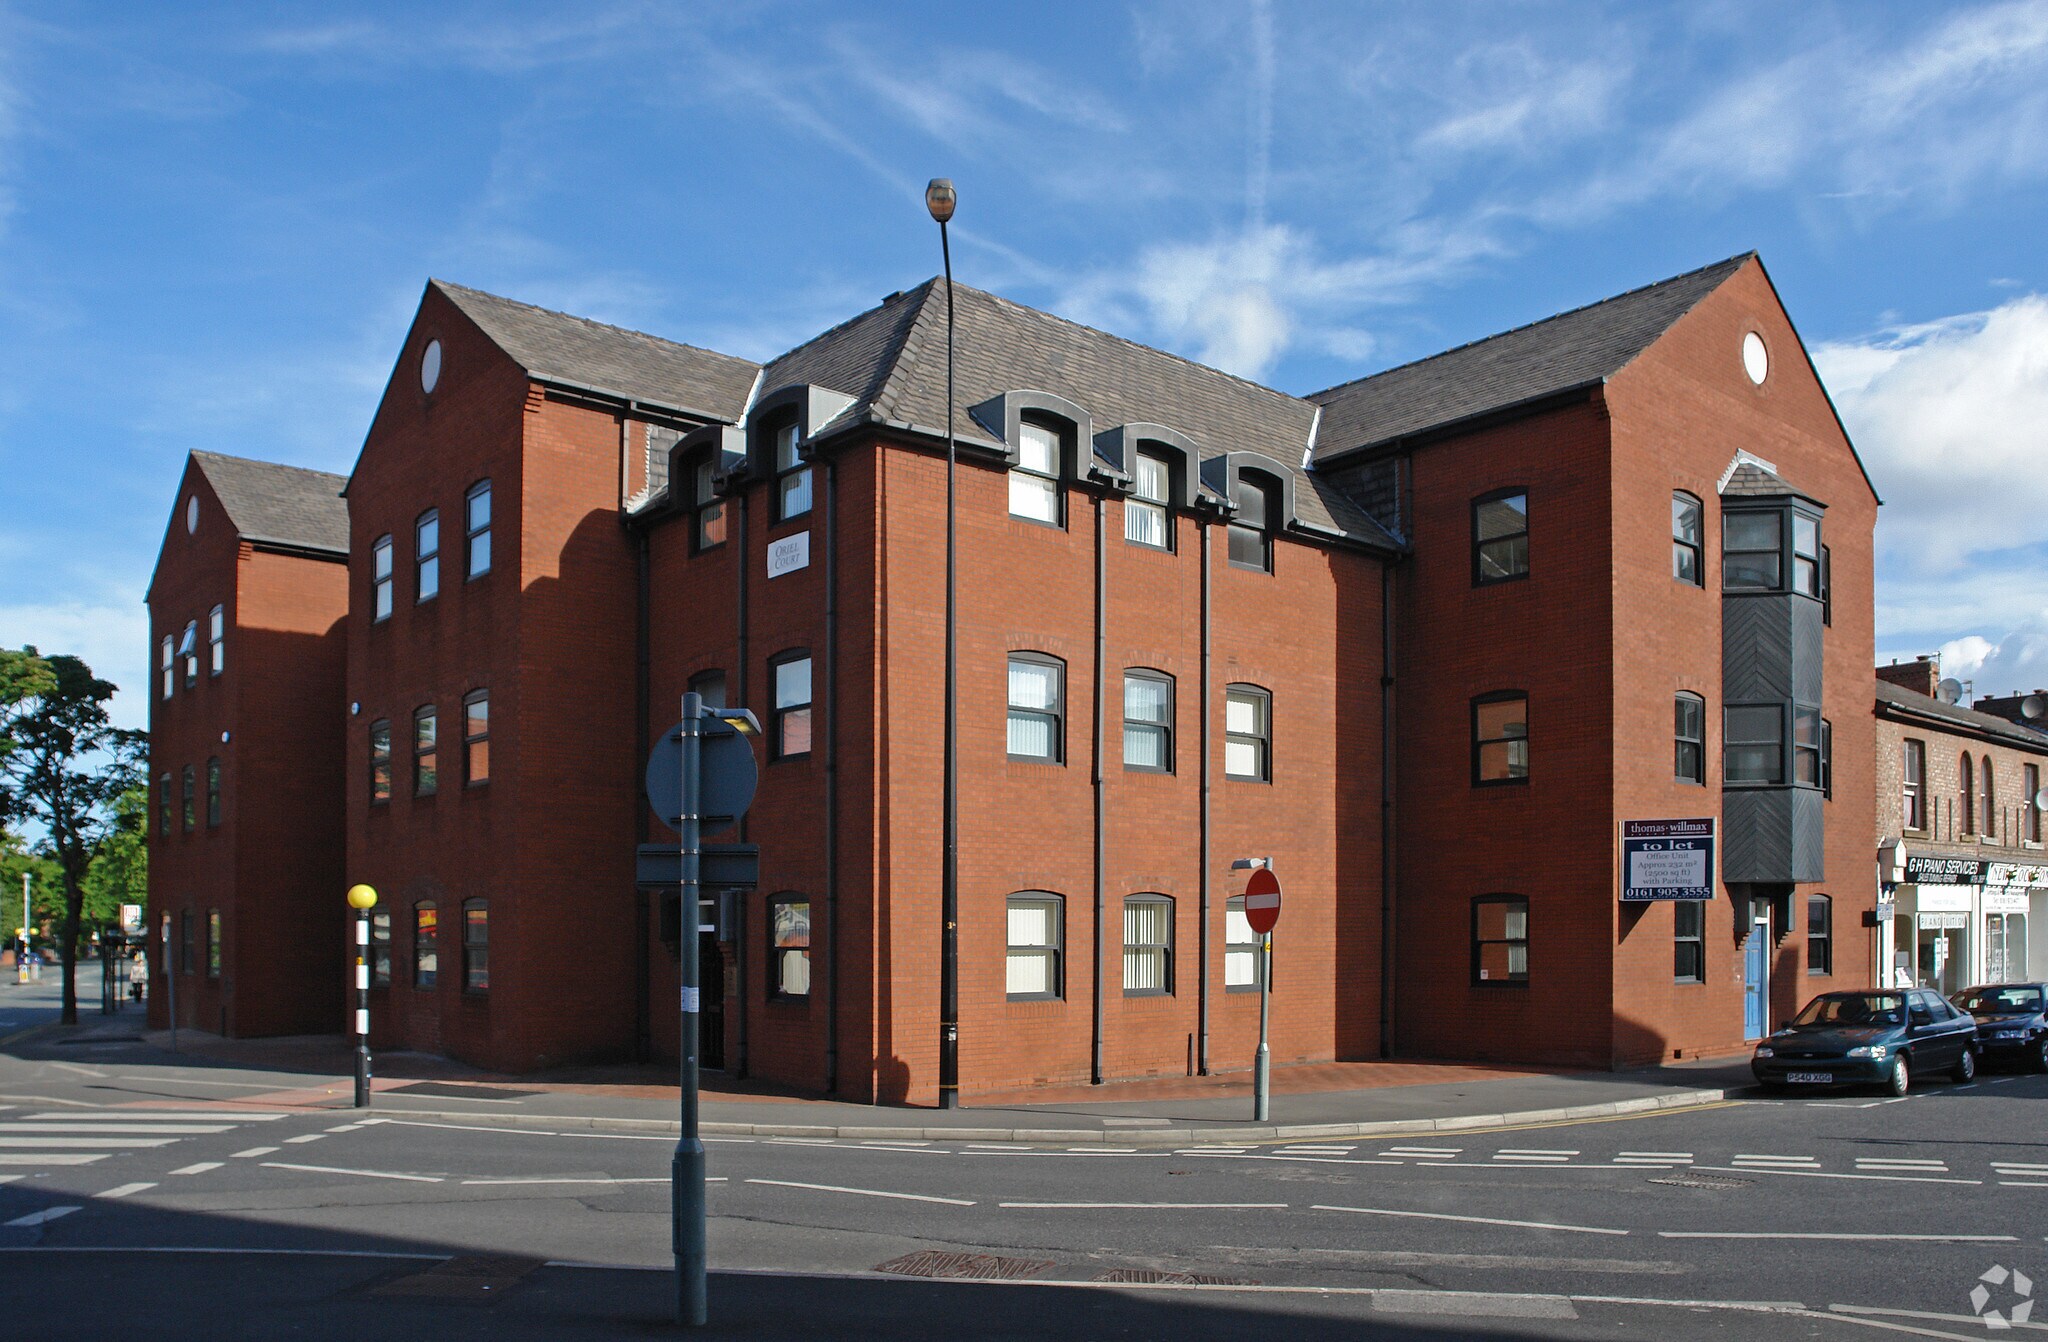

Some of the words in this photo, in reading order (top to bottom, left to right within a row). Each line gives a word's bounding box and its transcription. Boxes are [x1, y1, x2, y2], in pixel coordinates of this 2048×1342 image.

[1669, 821, 1708, 831] willmax
[1642, 842, 1662, 851] to
[1669, 840, 1695, 850] let
[1646, 852, 1670, 860] Office
[1638, 861, 1667, 869] Approx
[1945, 859, 1980, 875] SERVICES
[1644, 869, 1668, 878] (2500
[1643, 877, 1660, 885] with
[1662, 877, 1693, 885] Parking
[1626, 888, 1653, 897] 0161
[1657, 887, 1679, 896] 905
[1682, 887, 1711, 896] 3555
